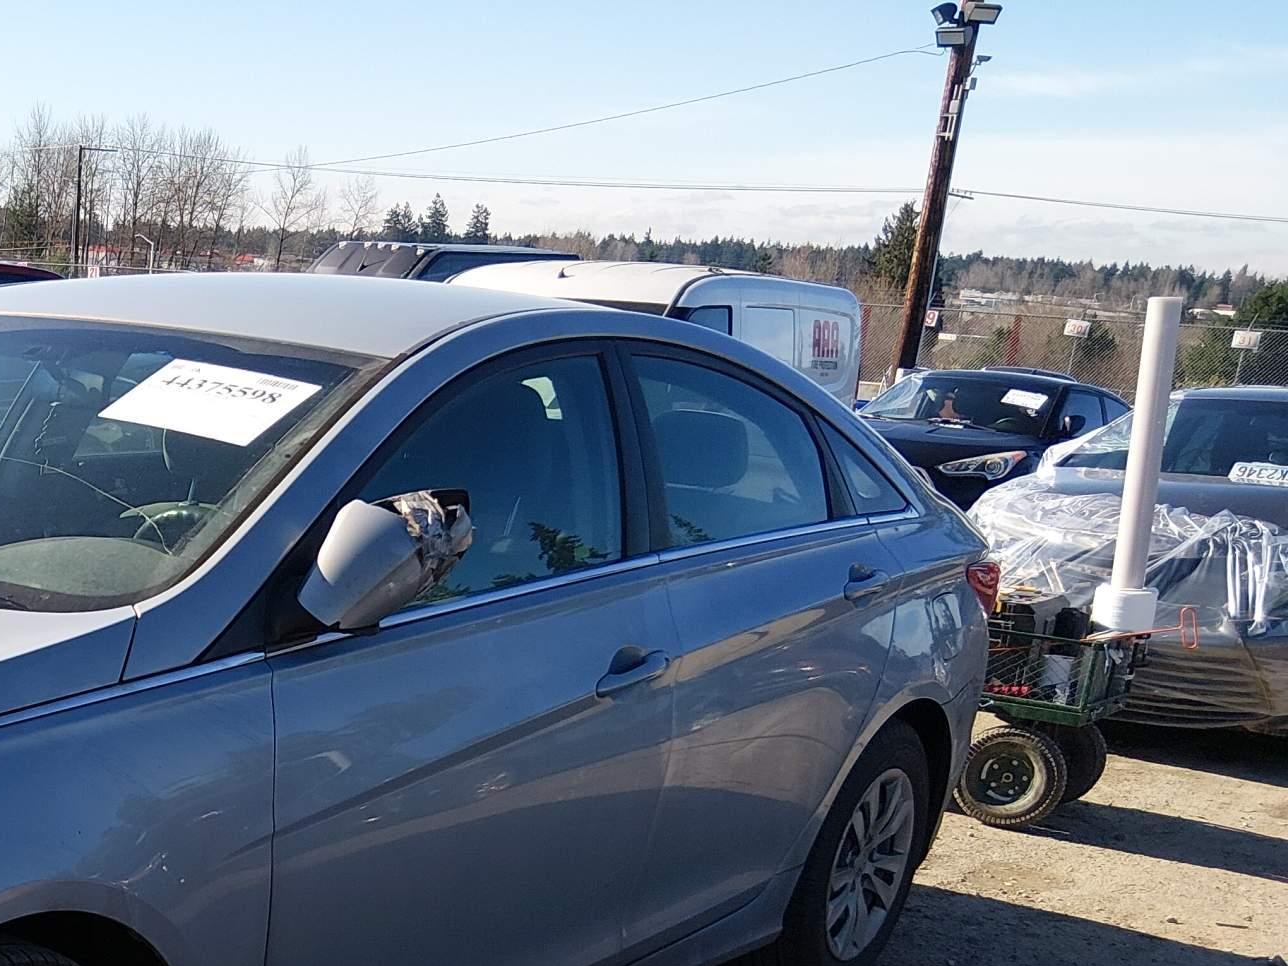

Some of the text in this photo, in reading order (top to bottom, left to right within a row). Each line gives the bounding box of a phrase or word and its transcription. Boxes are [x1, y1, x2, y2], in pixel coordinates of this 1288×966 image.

[813, 319, 839, 358] AAA
[1070, 324, 1083, 334] 30
[1238, 335, 1252, 346] 31
[162, 375, 283, 404] 44375598
